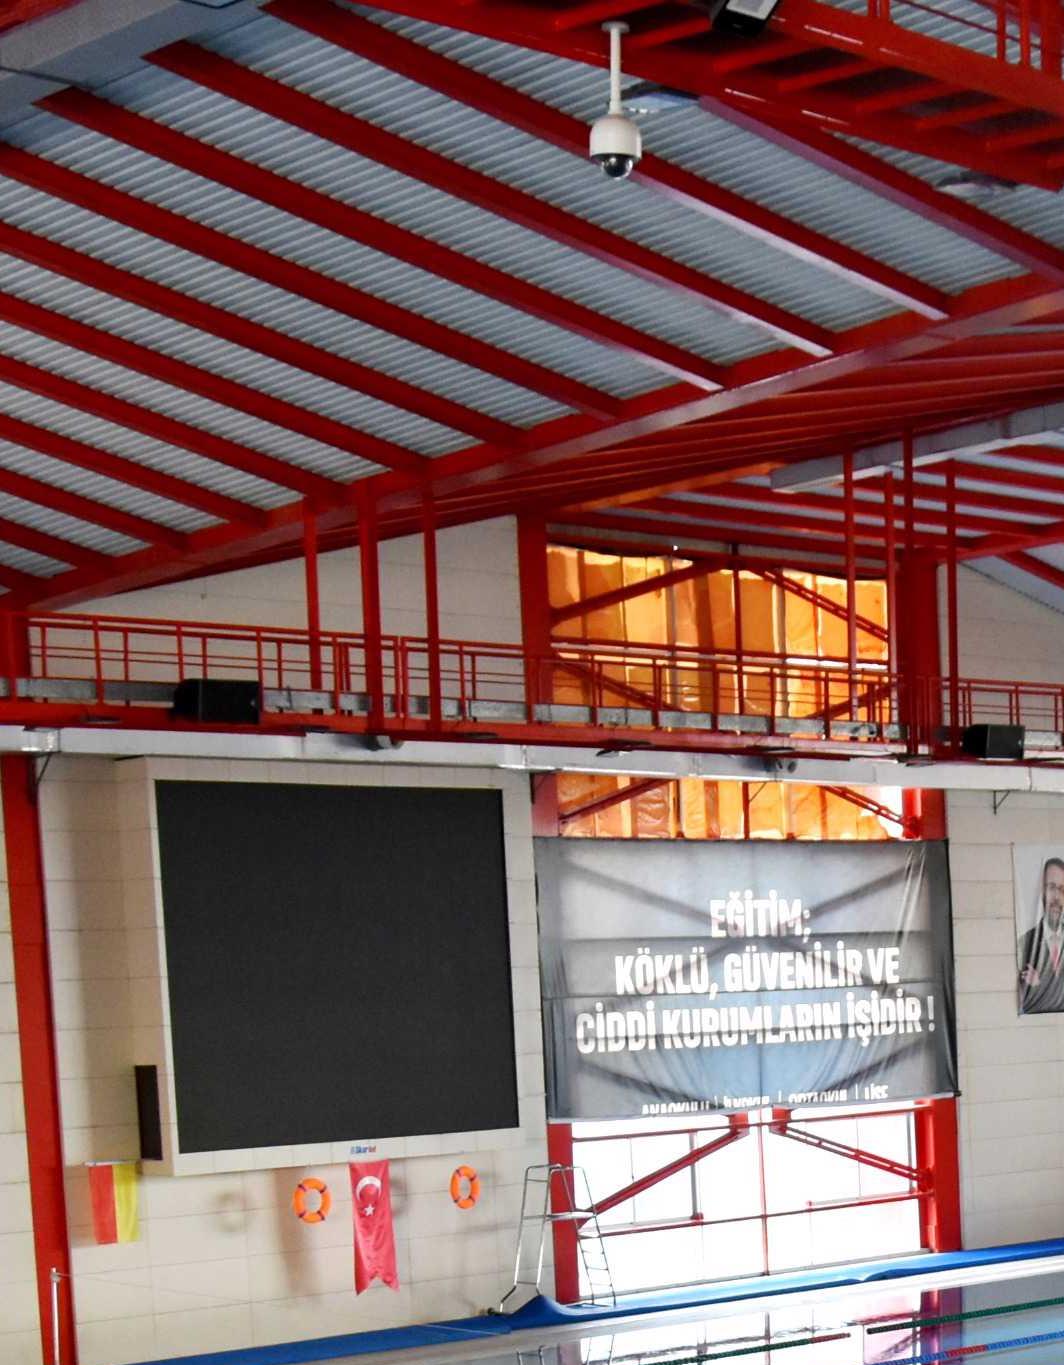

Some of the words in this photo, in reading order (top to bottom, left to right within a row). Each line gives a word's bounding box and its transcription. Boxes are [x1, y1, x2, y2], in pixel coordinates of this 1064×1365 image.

[710, 889, 811, 942] EĞİTİM;
[615, 947, 717, 1000] KÖKLÜ,
[723, 940, 863, 992] GÜVENİLİR
[869, 947, 900, 985] VE
[576, 1002, 657, 1054] CİDDİ
[662, 999, 841, 1049] KURUMLARIN
[846, 988, 923, 1047] İŞİDİR
